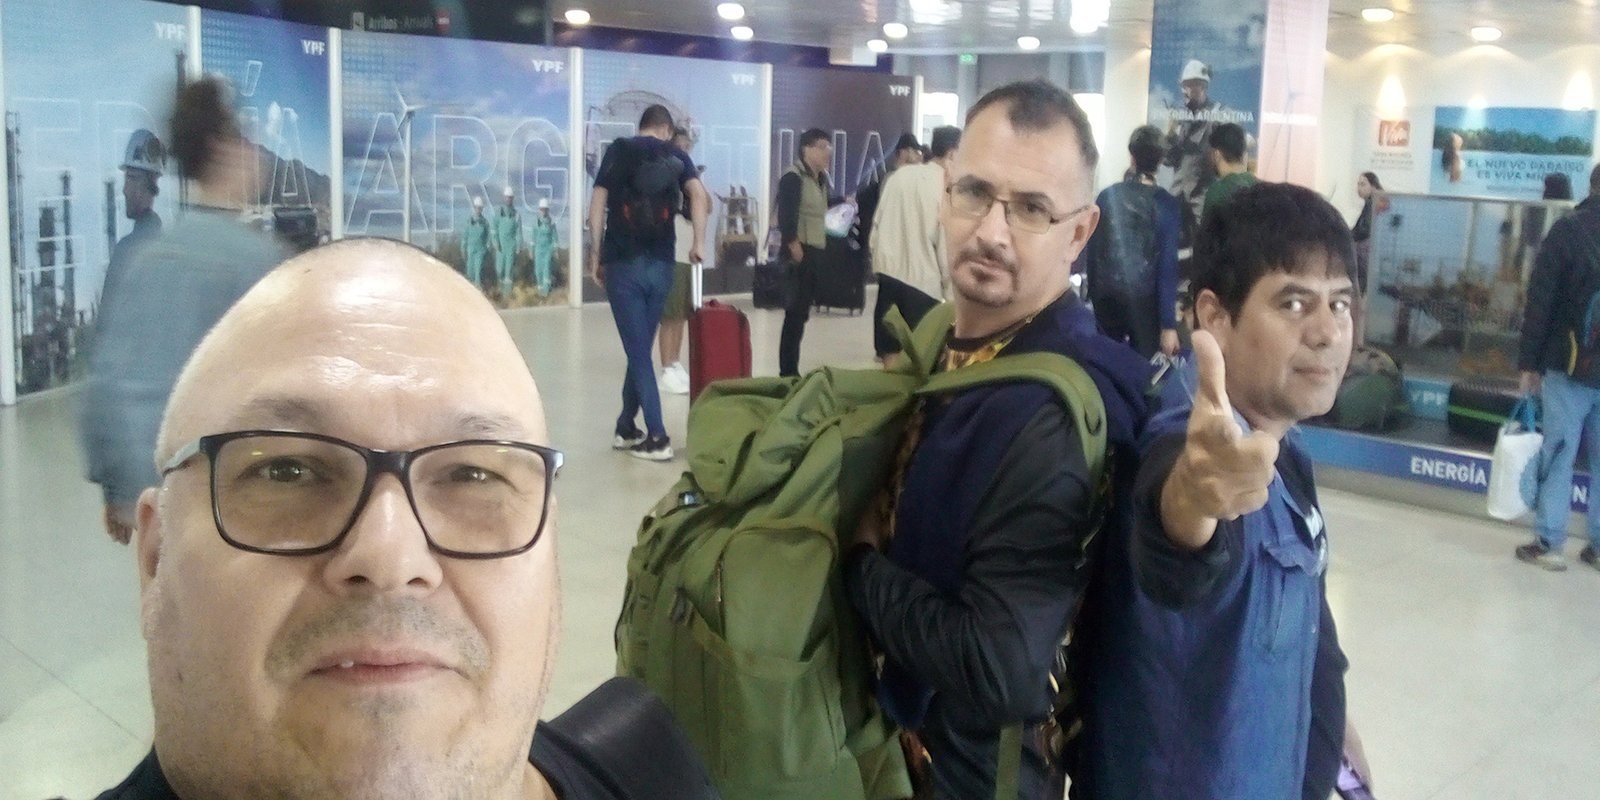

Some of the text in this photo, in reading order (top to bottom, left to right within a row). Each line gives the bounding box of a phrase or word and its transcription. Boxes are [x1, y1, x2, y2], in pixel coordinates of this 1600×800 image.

[155, 22, 186, 40] YPF
[303, 39, 326, 56] YPF
[531, 57, 564, 75] YPF
[731, 72, 758, 87] YPF
[889, 84, 911, 97] YPF
[1410, 457, 1488, 487] ENERGÍA
